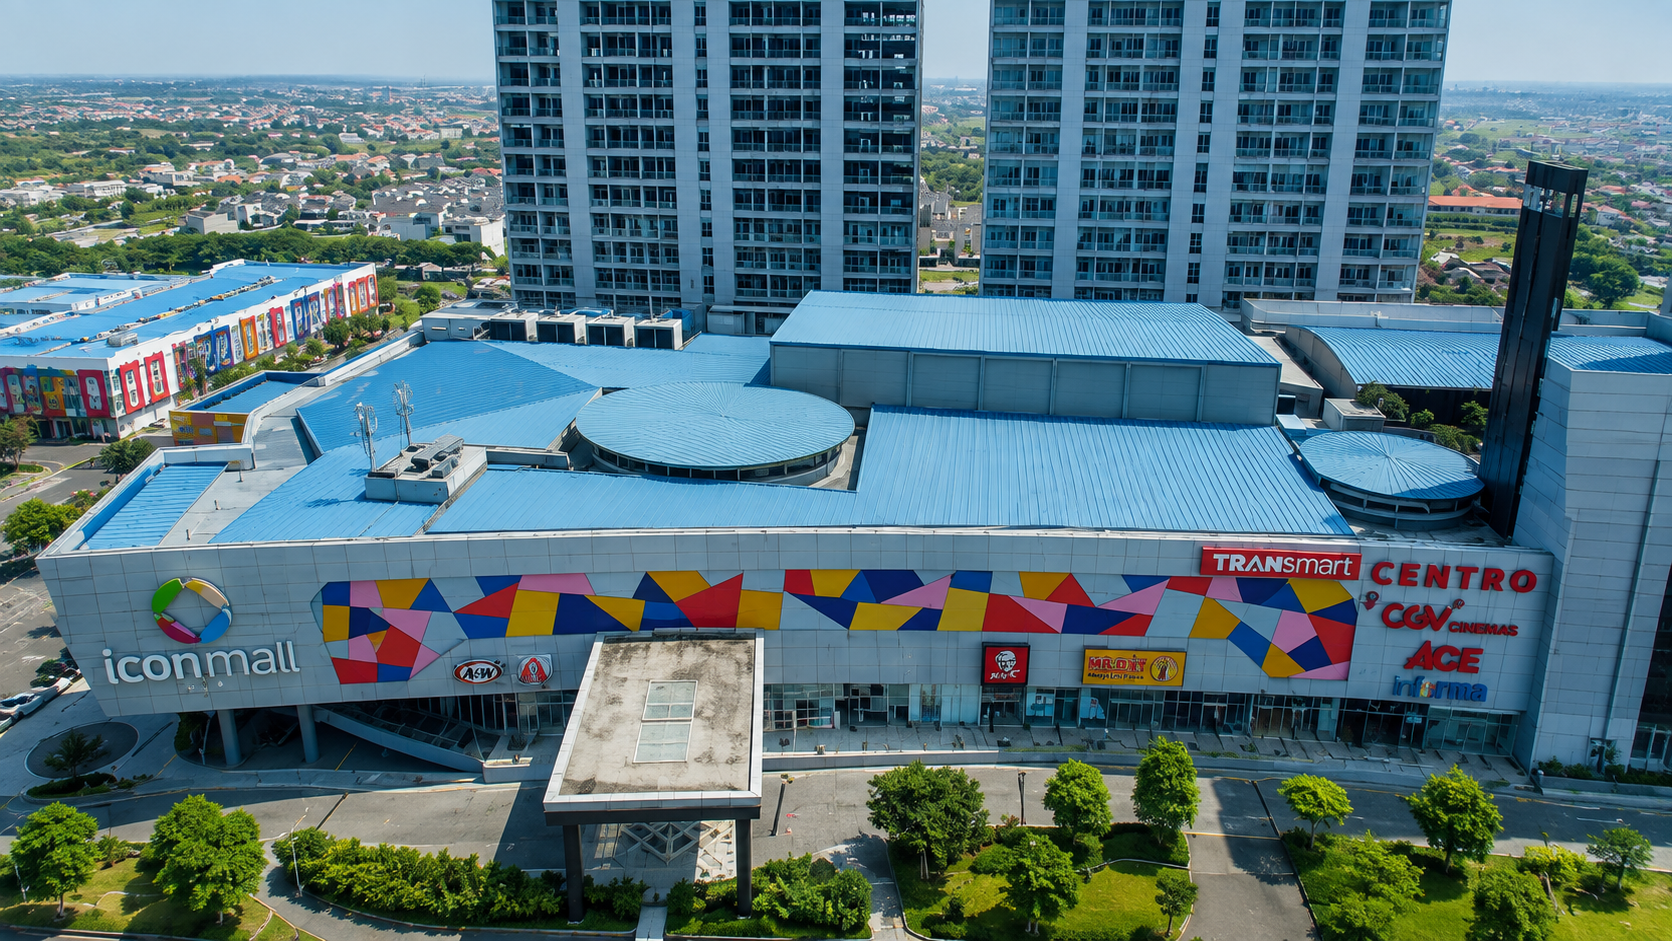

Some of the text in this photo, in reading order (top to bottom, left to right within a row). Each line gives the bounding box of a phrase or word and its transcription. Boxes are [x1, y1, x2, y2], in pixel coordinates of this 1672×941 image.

[1213, 554, 1353, 577] TRANsmart
[1371, 561, 1537, 593] CENTRO
[1382, 602, 1519, 636] CGV CINEMAS
[1404, 640, 1484, 673] ACE
[463, 667, 494, 680] A&W
[1392, 675, 1487, 702] informa
